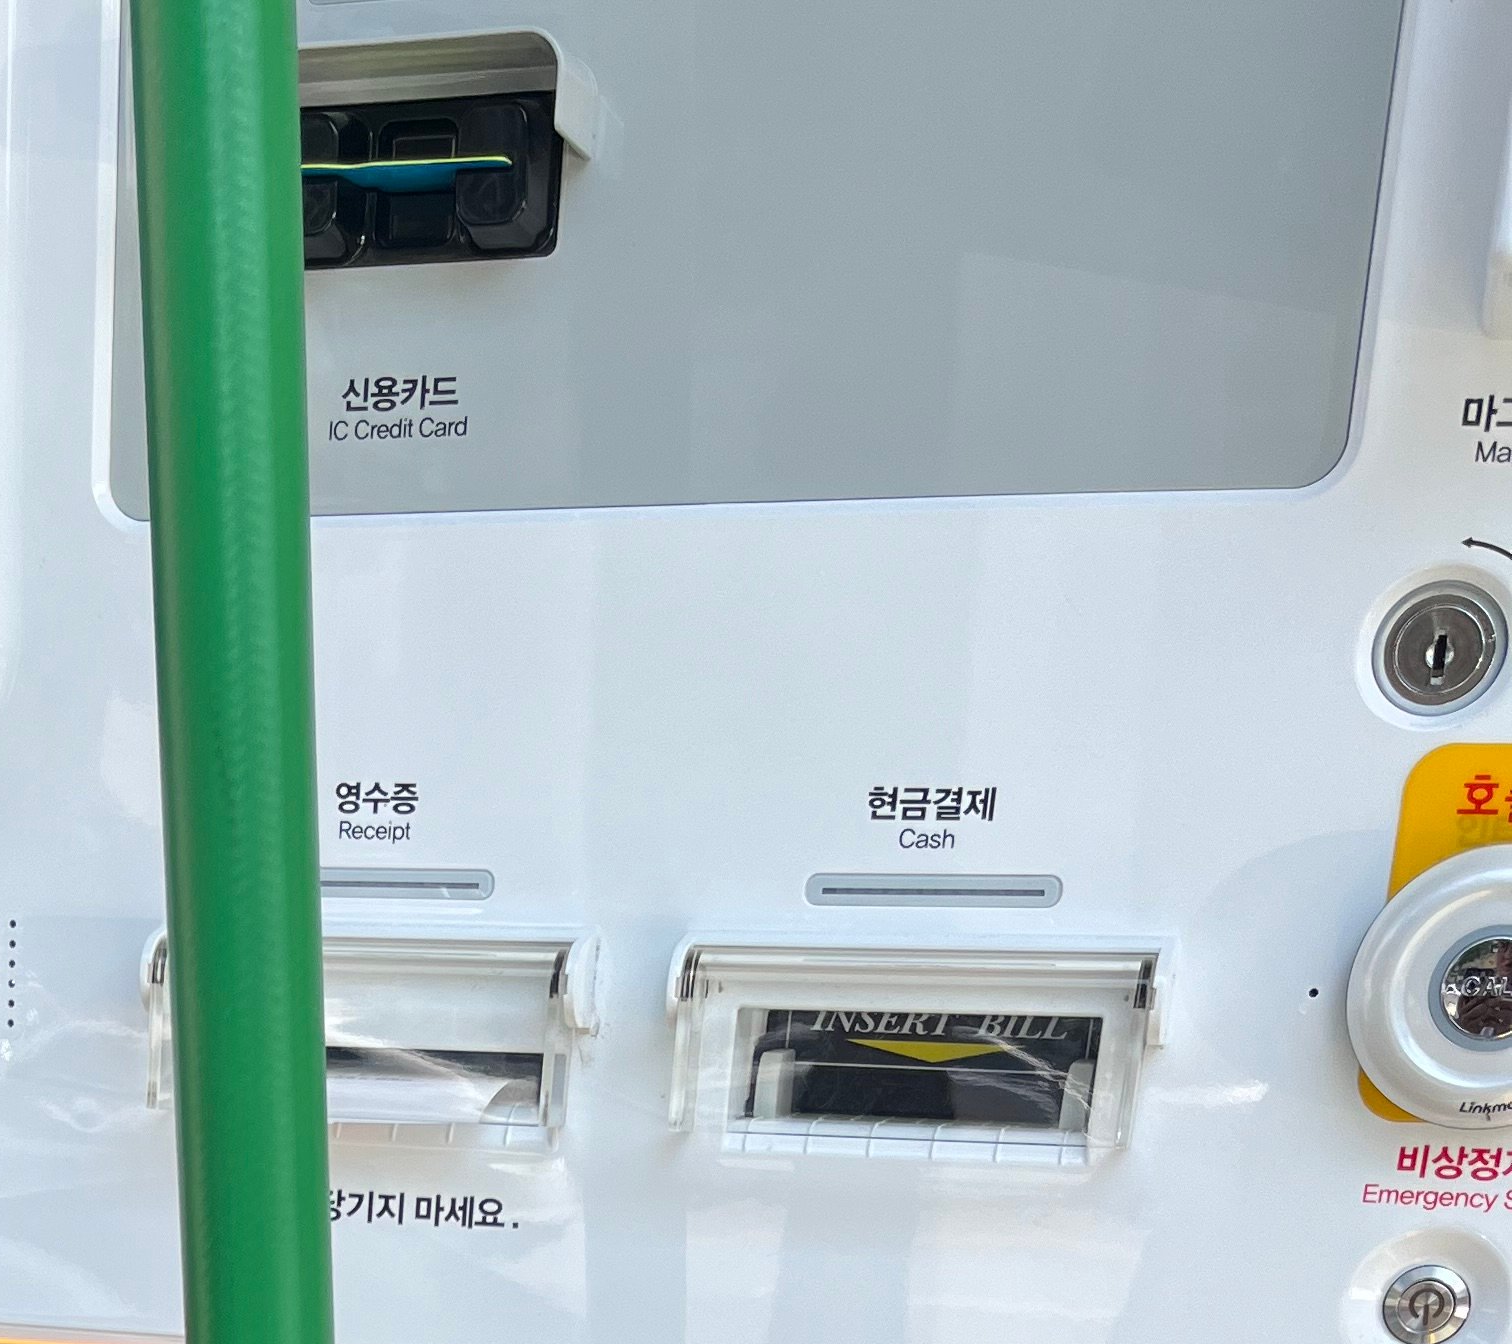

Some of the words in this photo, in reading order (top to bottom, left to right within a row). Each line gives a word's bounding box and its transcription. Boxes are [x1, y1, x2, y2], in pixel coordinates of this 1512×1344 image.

[341, 374, 460, 412] 신용카드
[329, 420, 349, 441] IC
[354, 417, 414, 440] Credit
[419, 416, 468, 438] Card
[335, 781, 419, 815] 영수증
[868, 786, 998, 822] 현금결제
[1456, 774, 1512, 823] 호
[338, 820, 411, 844] Receipt
[898, 828, 956, 849] Cash
[809, 1010, 960, 1037] INSERT
[977, 1014, 1069, 1041] BILL
[1396, 1144, 1512, 1182] 비상정
[414, 1194, 520, 1230] 마세요.
[1362, 1184, 1499, 1213] Emergency
